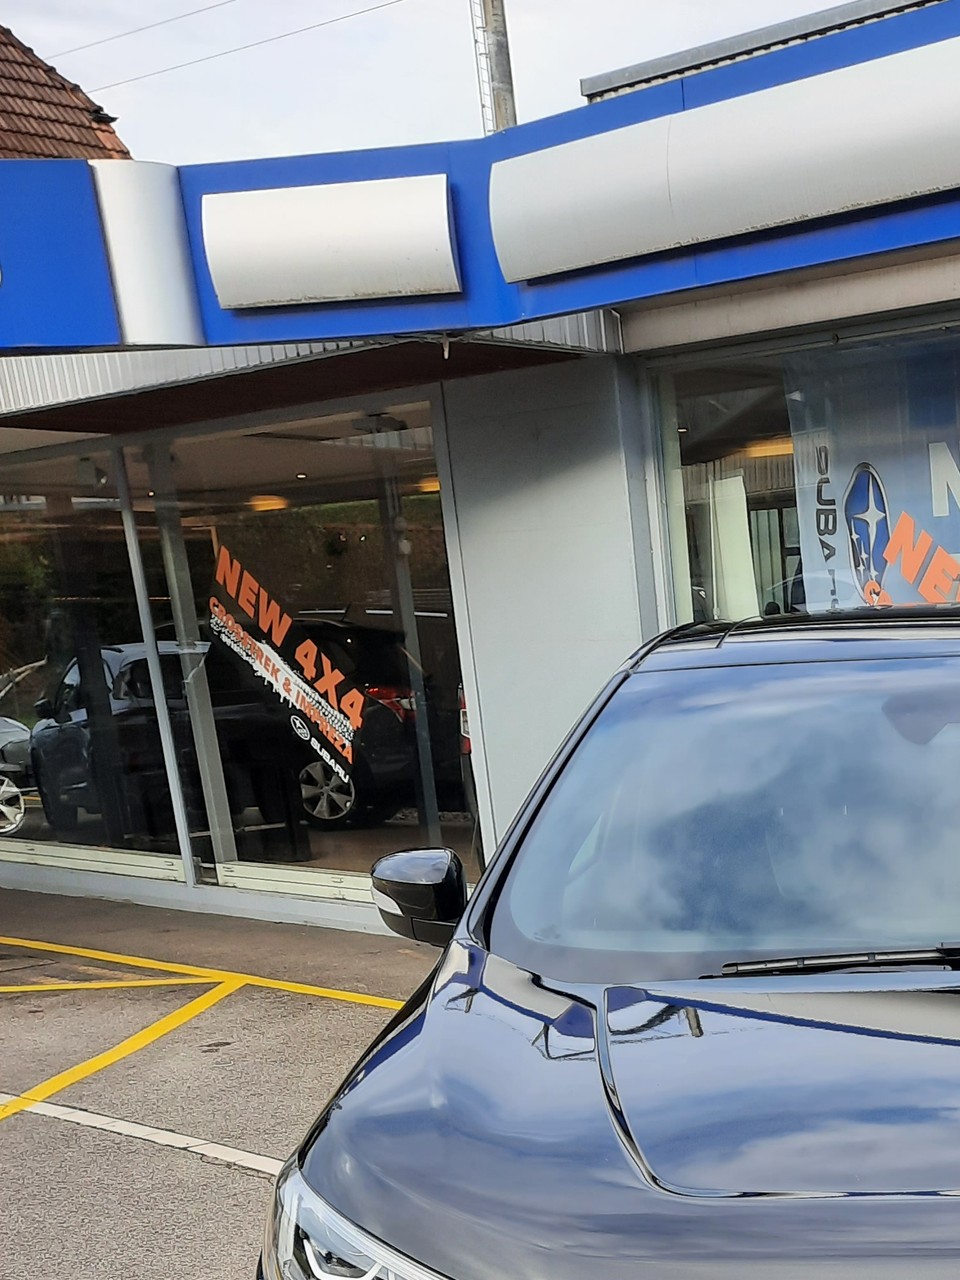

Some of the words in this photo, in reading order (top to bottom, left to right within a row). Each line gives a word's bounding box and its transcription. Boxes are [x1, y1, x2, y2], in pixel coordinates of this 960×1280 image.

[215, 544, 293, 648] NEW
[295, 638, 365, 731] 4X4
[295, 689, 354, 765] IMPREZA
[310, 736, 350, 784] SUBARU
